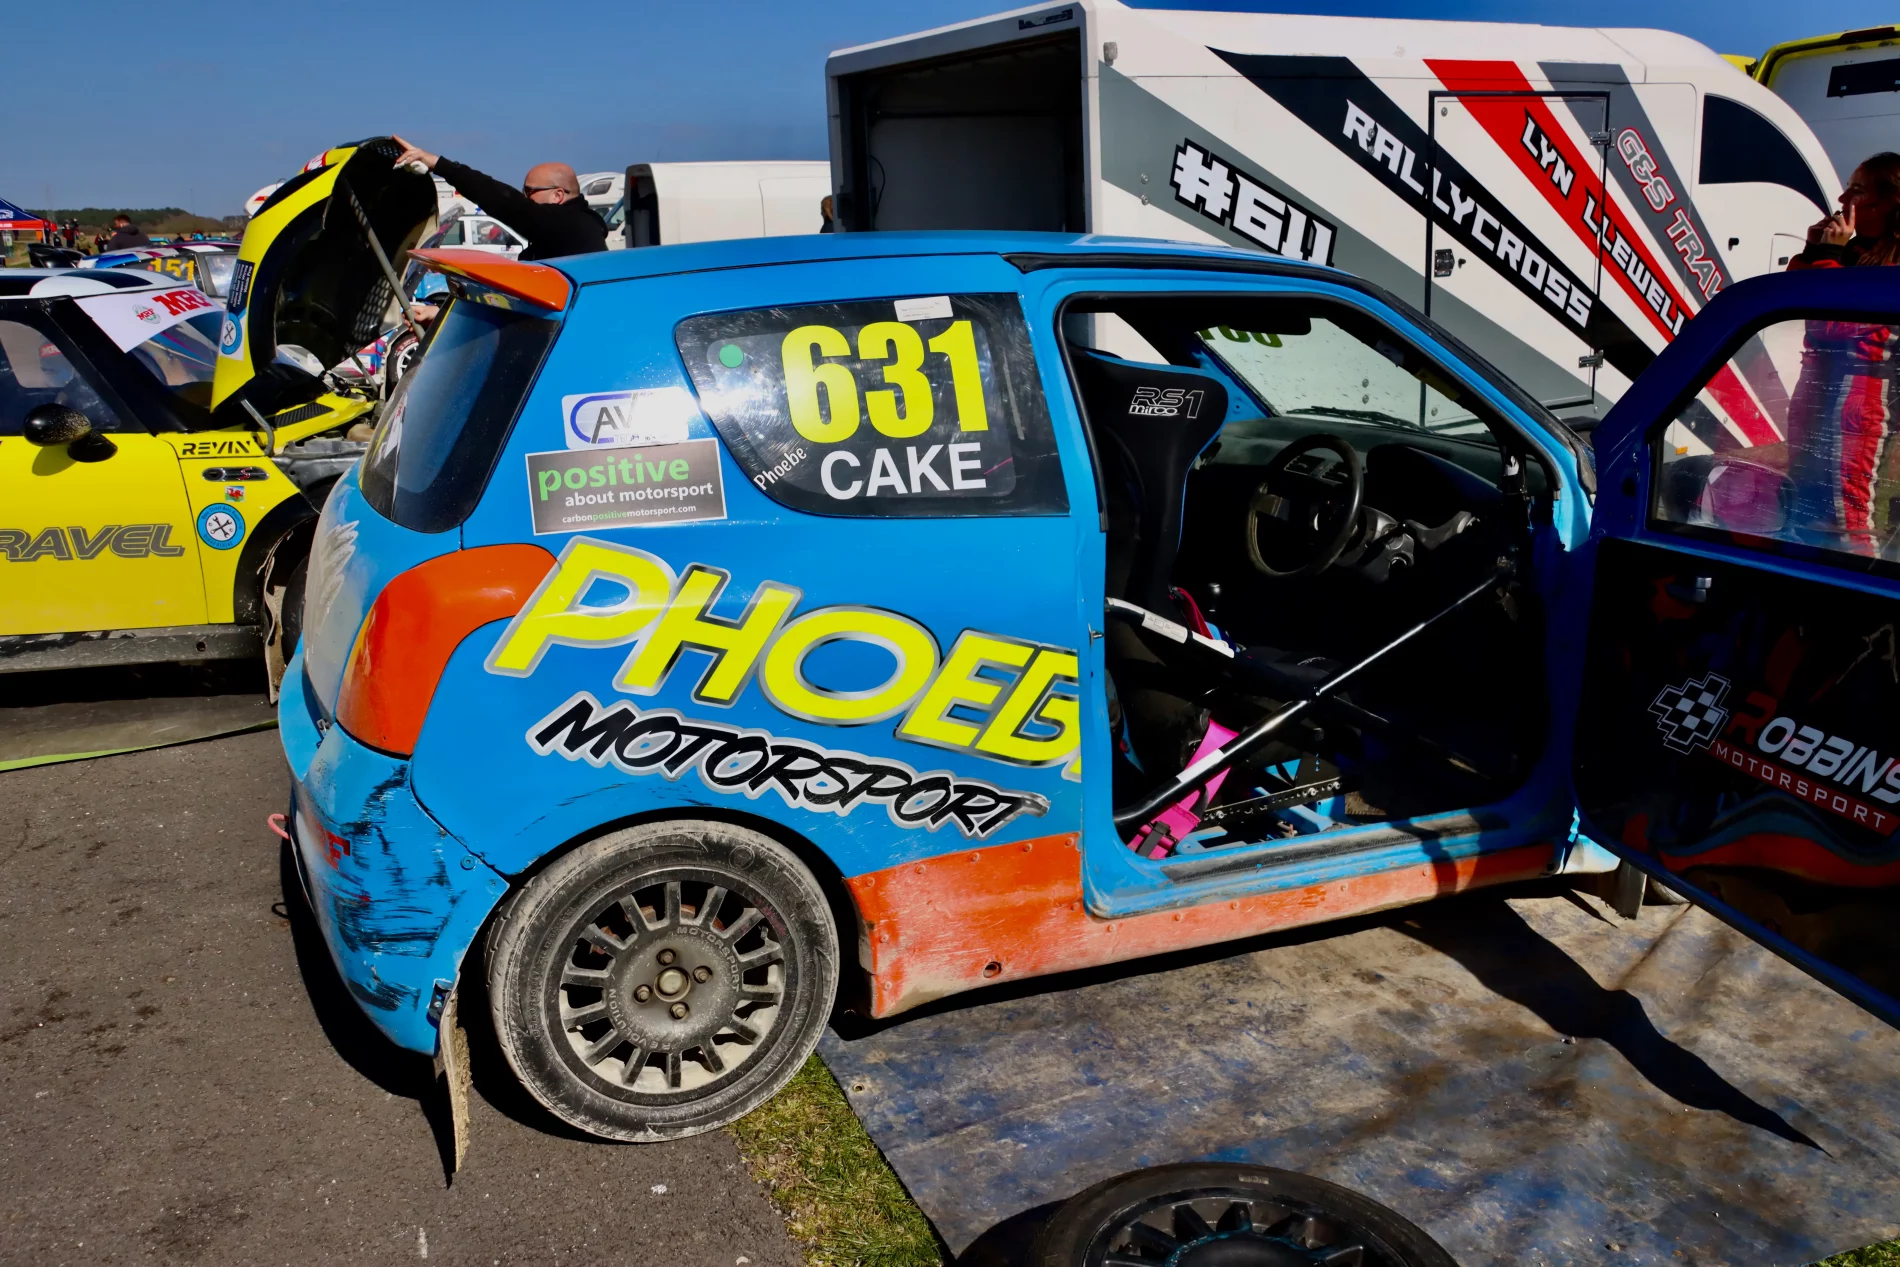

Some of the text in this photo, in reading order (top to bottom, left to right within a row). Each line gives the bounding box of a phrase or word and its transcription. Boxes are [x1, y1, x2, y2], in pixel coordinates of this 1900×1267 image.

[1521, 113, 1575, 196] LYN
[1617, 128, 1675, 212] G&S
[1342, 98, 1592, 329] RALLYCROSS
[149, 257, 195, 281] 151
[781, 320, 989, 444] 631
[538, 453, 690, 501] positive
[565, 482, 713, 508] about motorsport
[753, 447, 807, 491] Phoebe
[820, 442, 987, 500] CAKE
[562, 504, 697, 524] carbonpositivemotorsport.com
[490, 540, 1081, 777] PHOEB
[532, 698, 1046, 834] MOTORSPORT
[1716, 742, 1887, 829] MOTORSPORT
[677, 925, 741, 992] MOTORSPORT
[608, 988, 671, 1050] REVOLUTION
